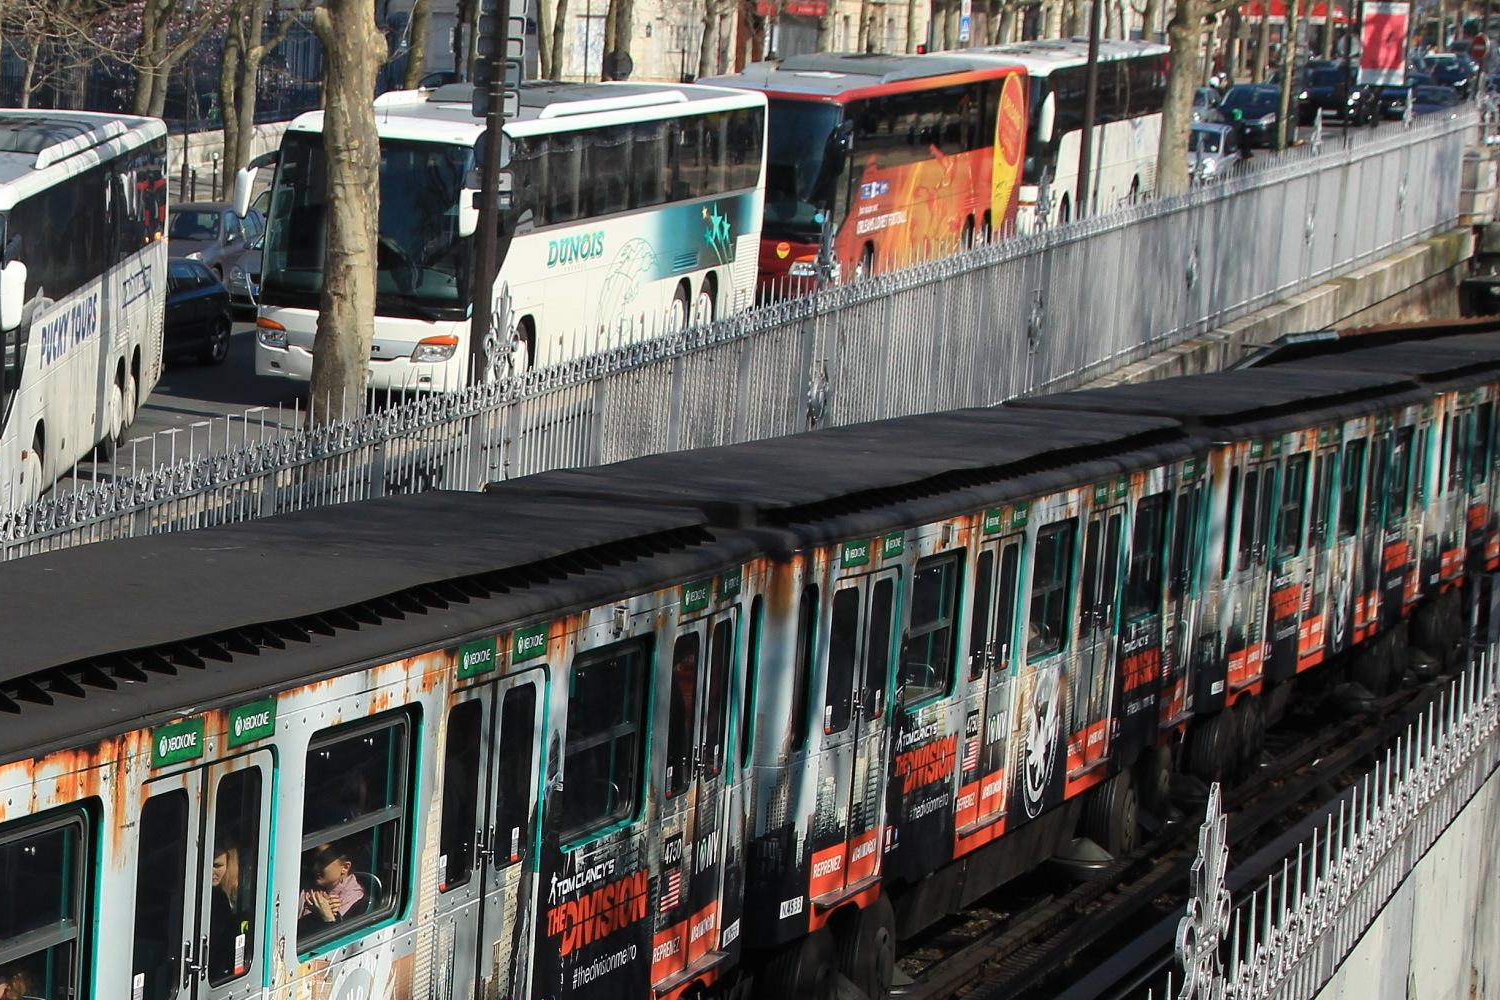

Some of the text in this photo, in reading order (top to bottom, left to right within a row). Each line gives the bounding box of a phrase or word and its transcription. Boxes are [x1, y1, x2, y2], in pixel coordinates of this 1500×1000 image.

[547, 231, 604, 267] DUNOIS
[40, 293, 97, 370] PUCKY TOURS
[557, 859, 615, 897] TOM CLANCY'S
[547, 868, 648, 958] THE DIVISION
